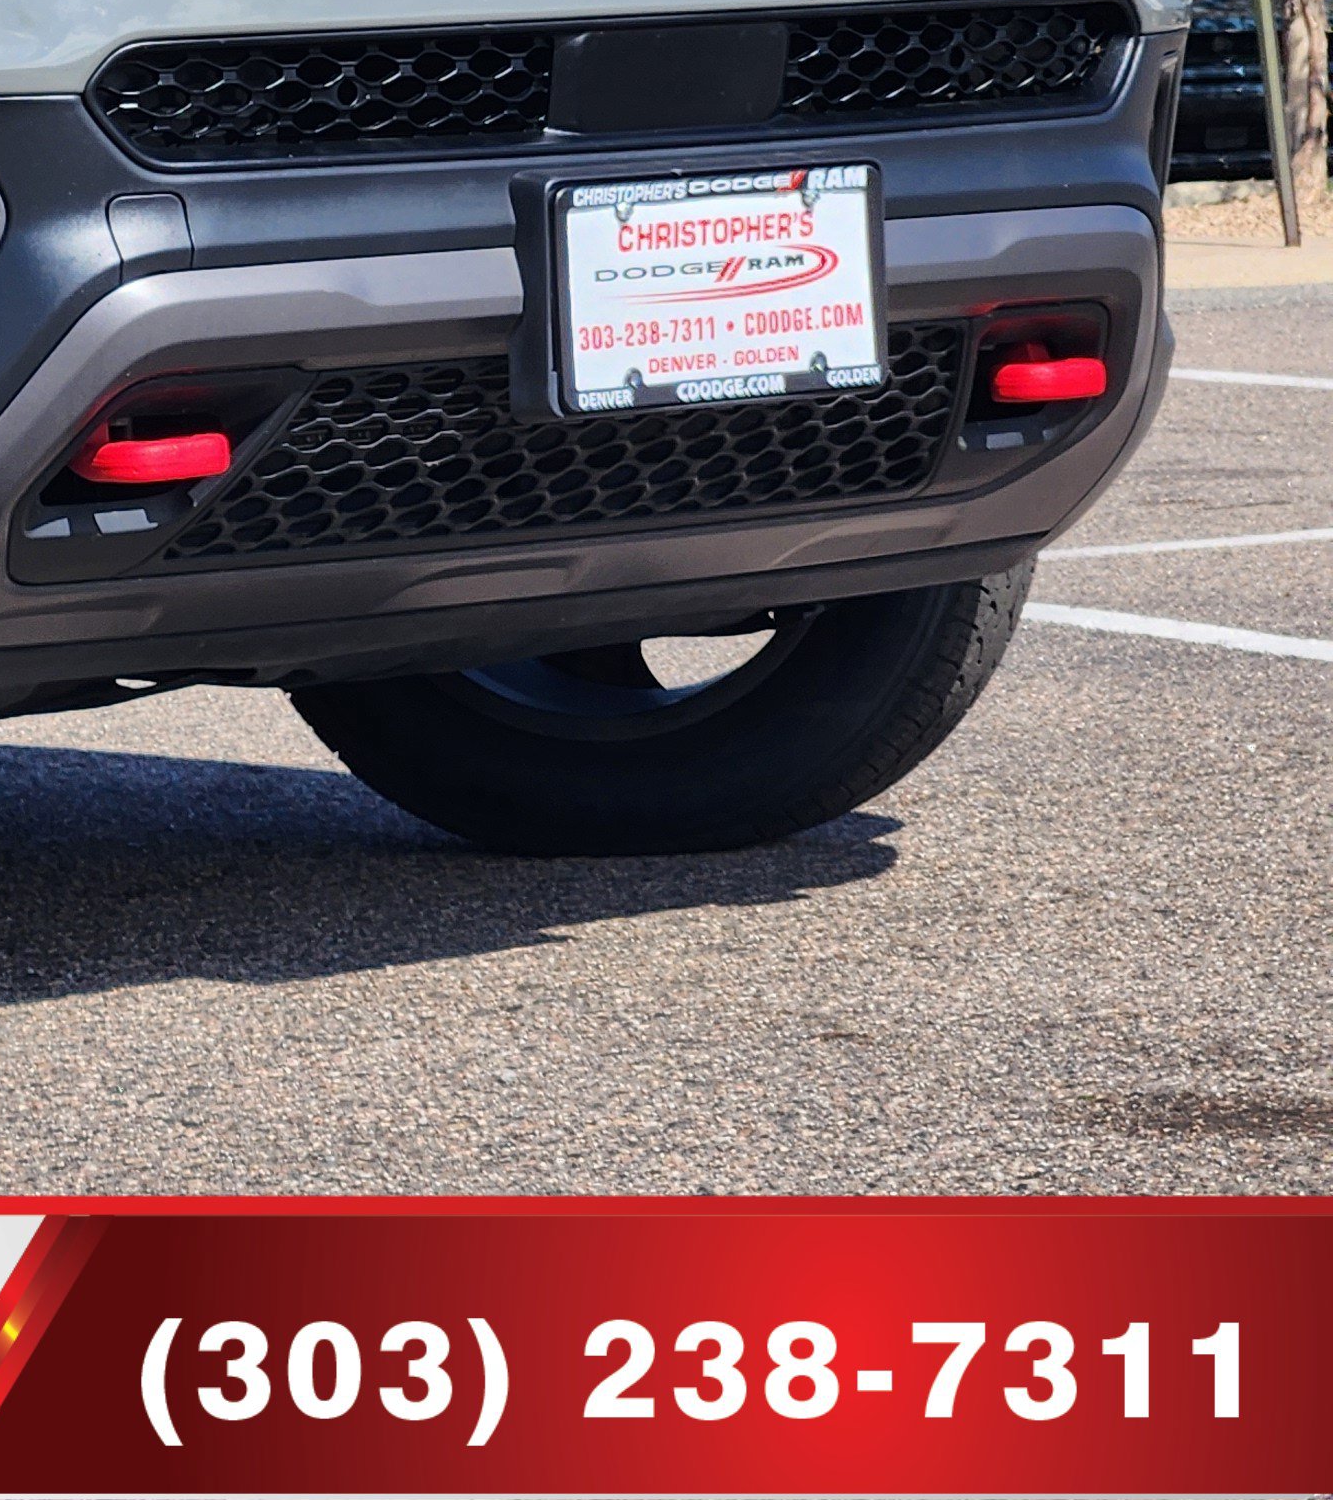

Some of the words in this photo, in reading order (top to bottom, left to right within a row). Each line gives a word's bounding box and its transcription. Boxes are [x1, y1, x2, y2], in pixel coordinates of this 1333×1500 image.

[688, 174, 791, 194] DODGE
[808, 165, 869, 190] RAM
[618, 212, 814, 252] CHRISTOPHER'S
[594, 260, 723, 283] DODGE
[747, 254, 805, 271] RAM
[578, 315, 716, 351] 303-238-7311
[744, 303, 864, 337] CDODGE.COM
[648, 353, 717, 375] DENVER
[734, 345, 800, 367] GOLDEN
[676, 374, 786, 403] CDODGE.COM
[826, 365, 882, 389] GOLDEN
[578, 387, 634, 411] DENVER
